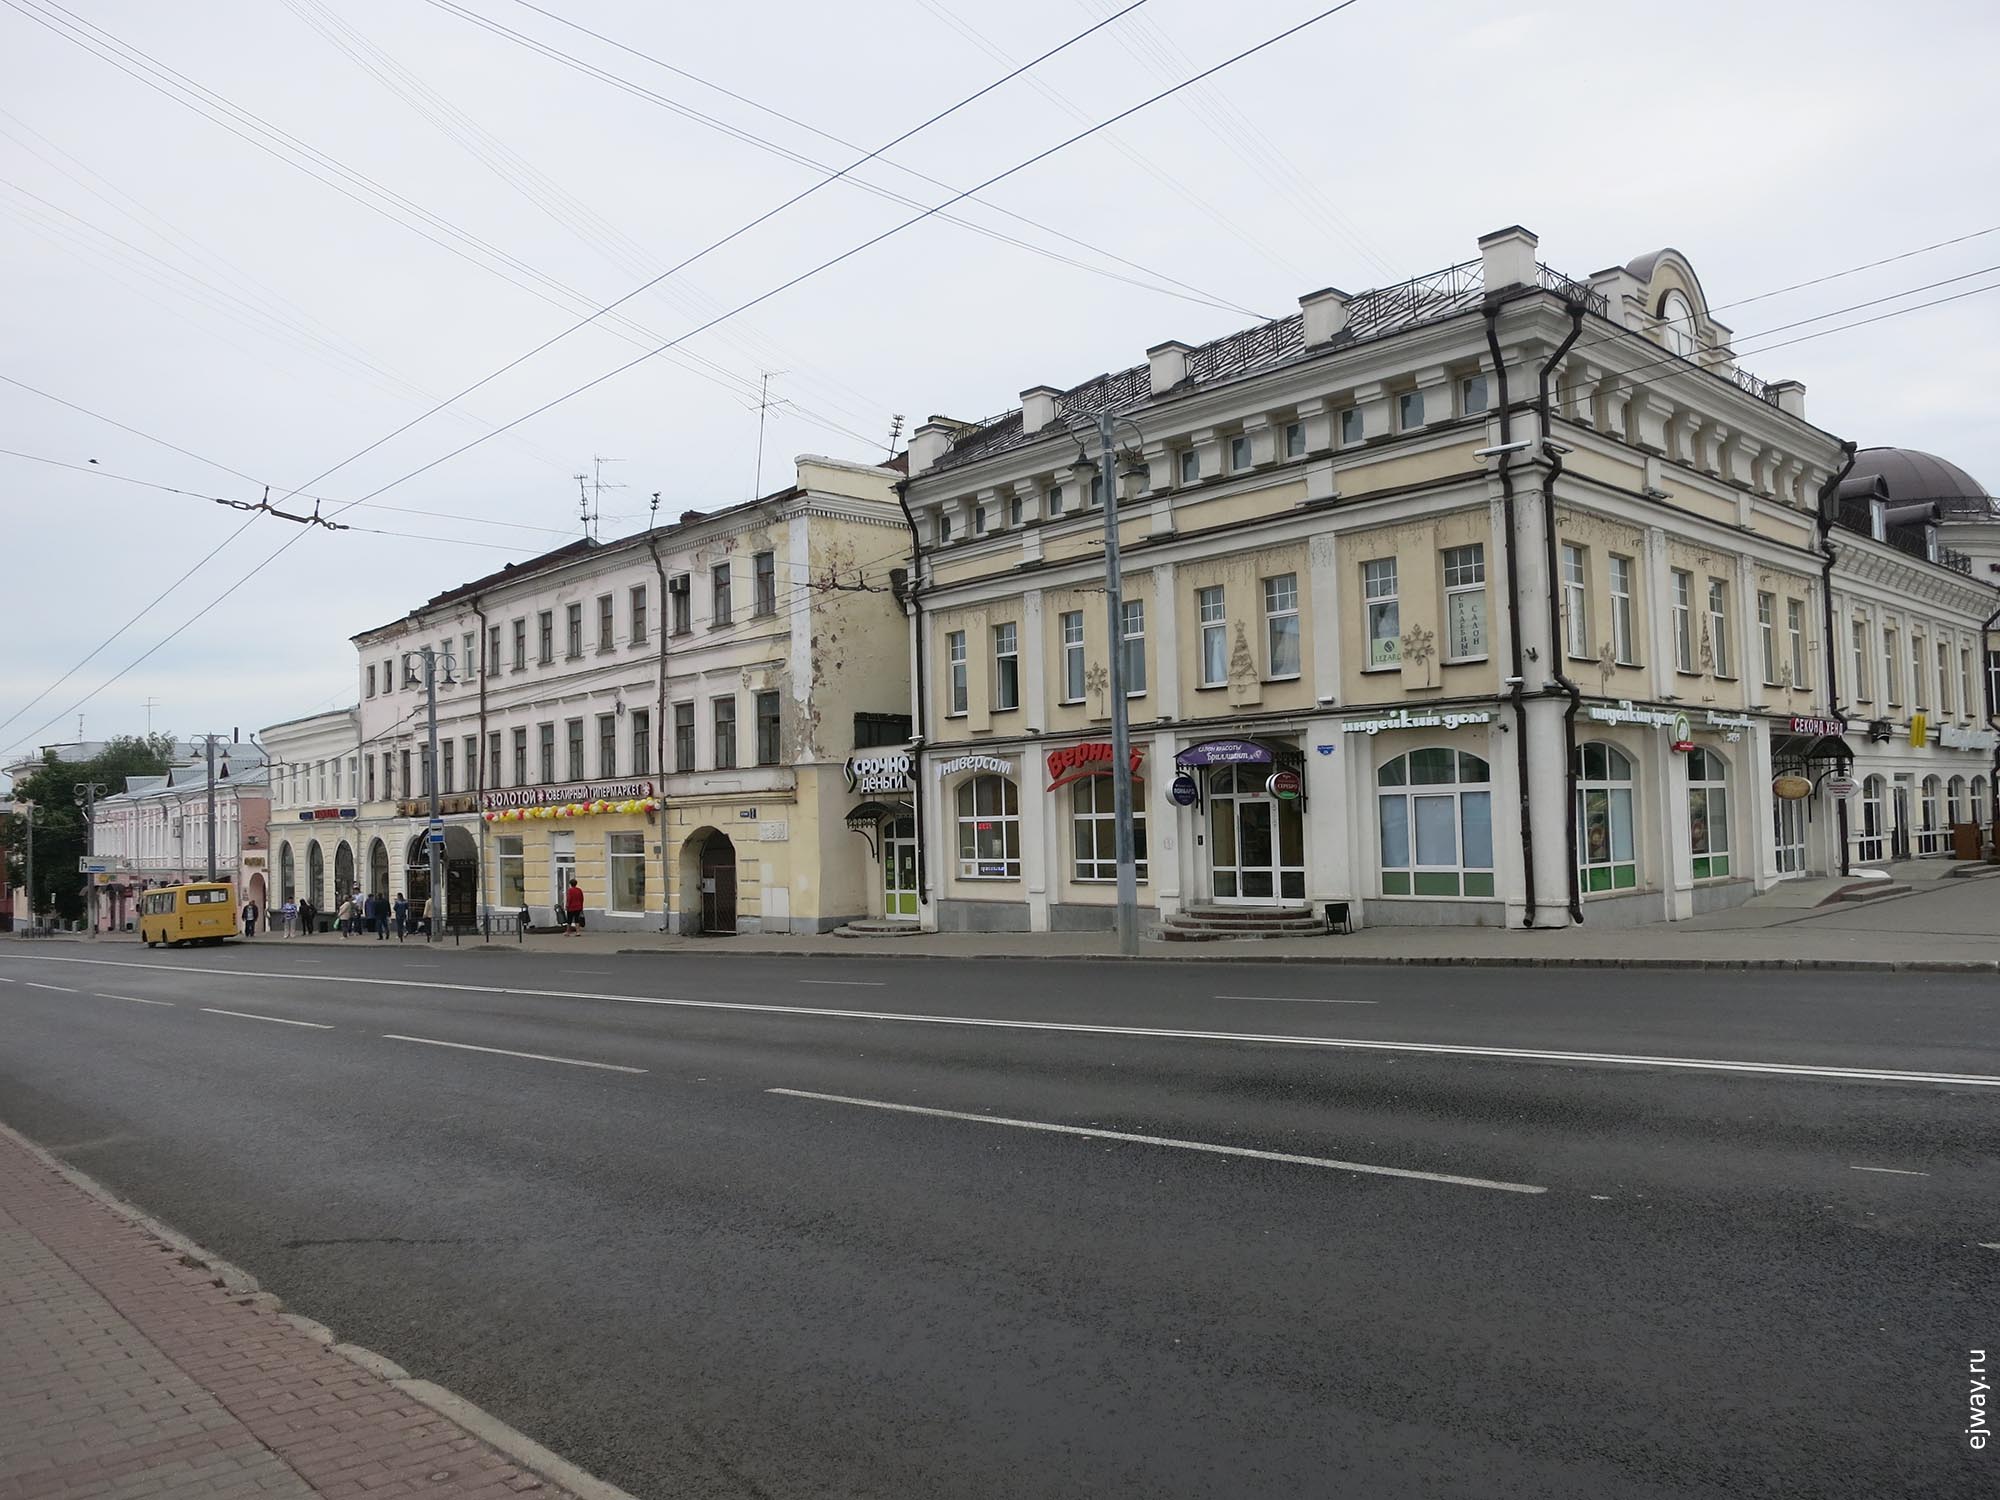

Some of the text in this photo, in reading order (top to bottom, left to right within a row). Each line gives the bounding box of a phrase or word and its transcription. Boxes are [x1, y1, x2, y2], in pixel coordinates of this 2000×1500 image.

[1471, 605, 1480, 645] САЛОН
[1442, 712, 1490, 730] дом
[1794, 718, 1844, 737] СЕКОНД ХЕНД
[853, 756, 909, 775] СРОЧНО
[490, 789, 537, 807] ЗОЛОТОЙ
[545, 786, 588, 802] ЮВЕЛИРНЫЙ
[589, 784, 641, 800] ГИПЕРМАРКЕТ
